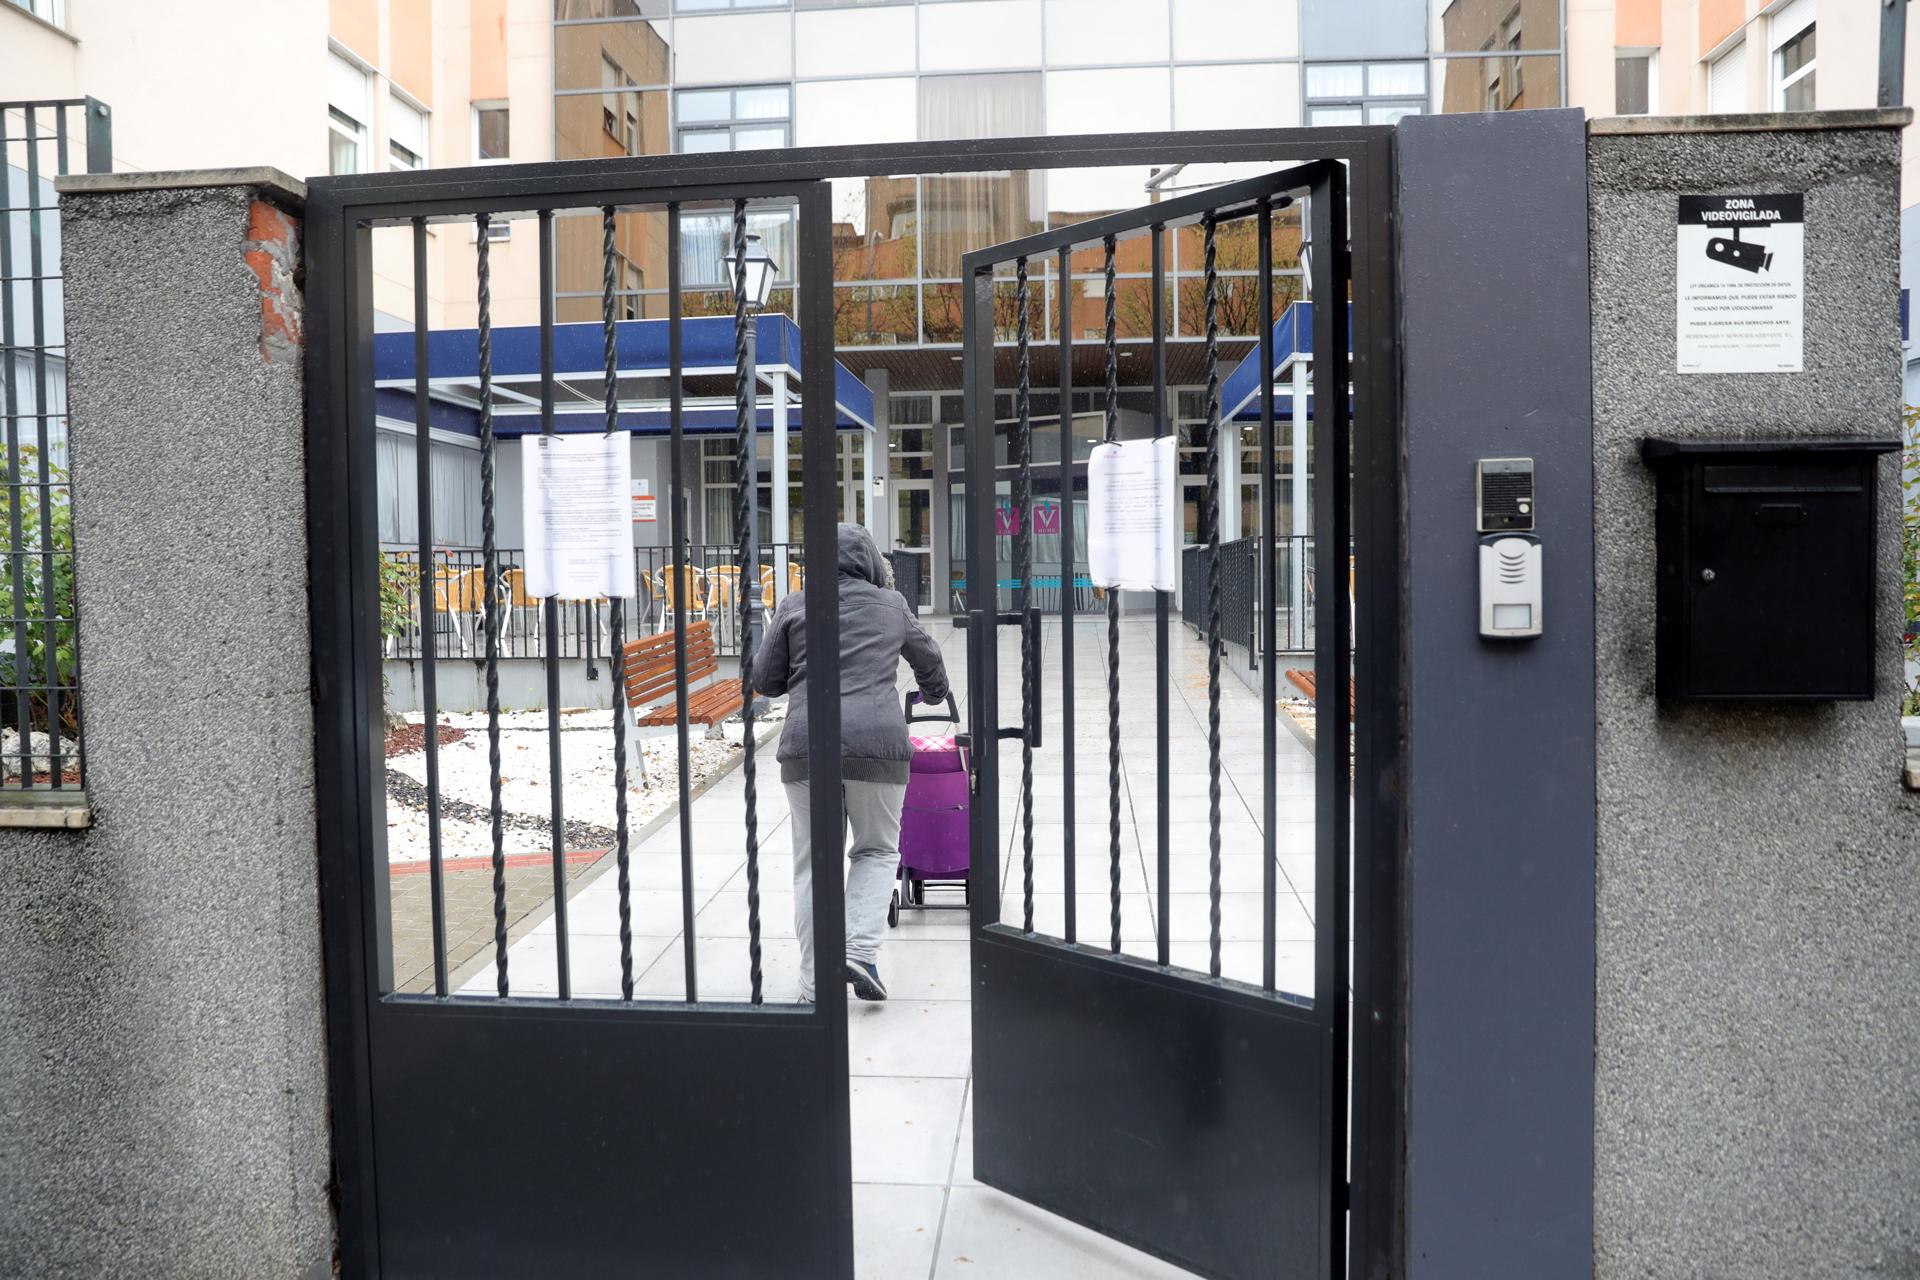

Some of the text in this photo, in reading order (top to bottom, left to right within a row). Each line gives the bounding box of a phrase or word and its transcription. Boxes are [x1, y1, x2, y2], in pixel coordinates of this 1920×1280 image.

[1725, 199, 1755, 209] ZONA
[1701, 210, 1782, 221] VIDEOVIGILADA
[1038, 510, 1056, 528] V
